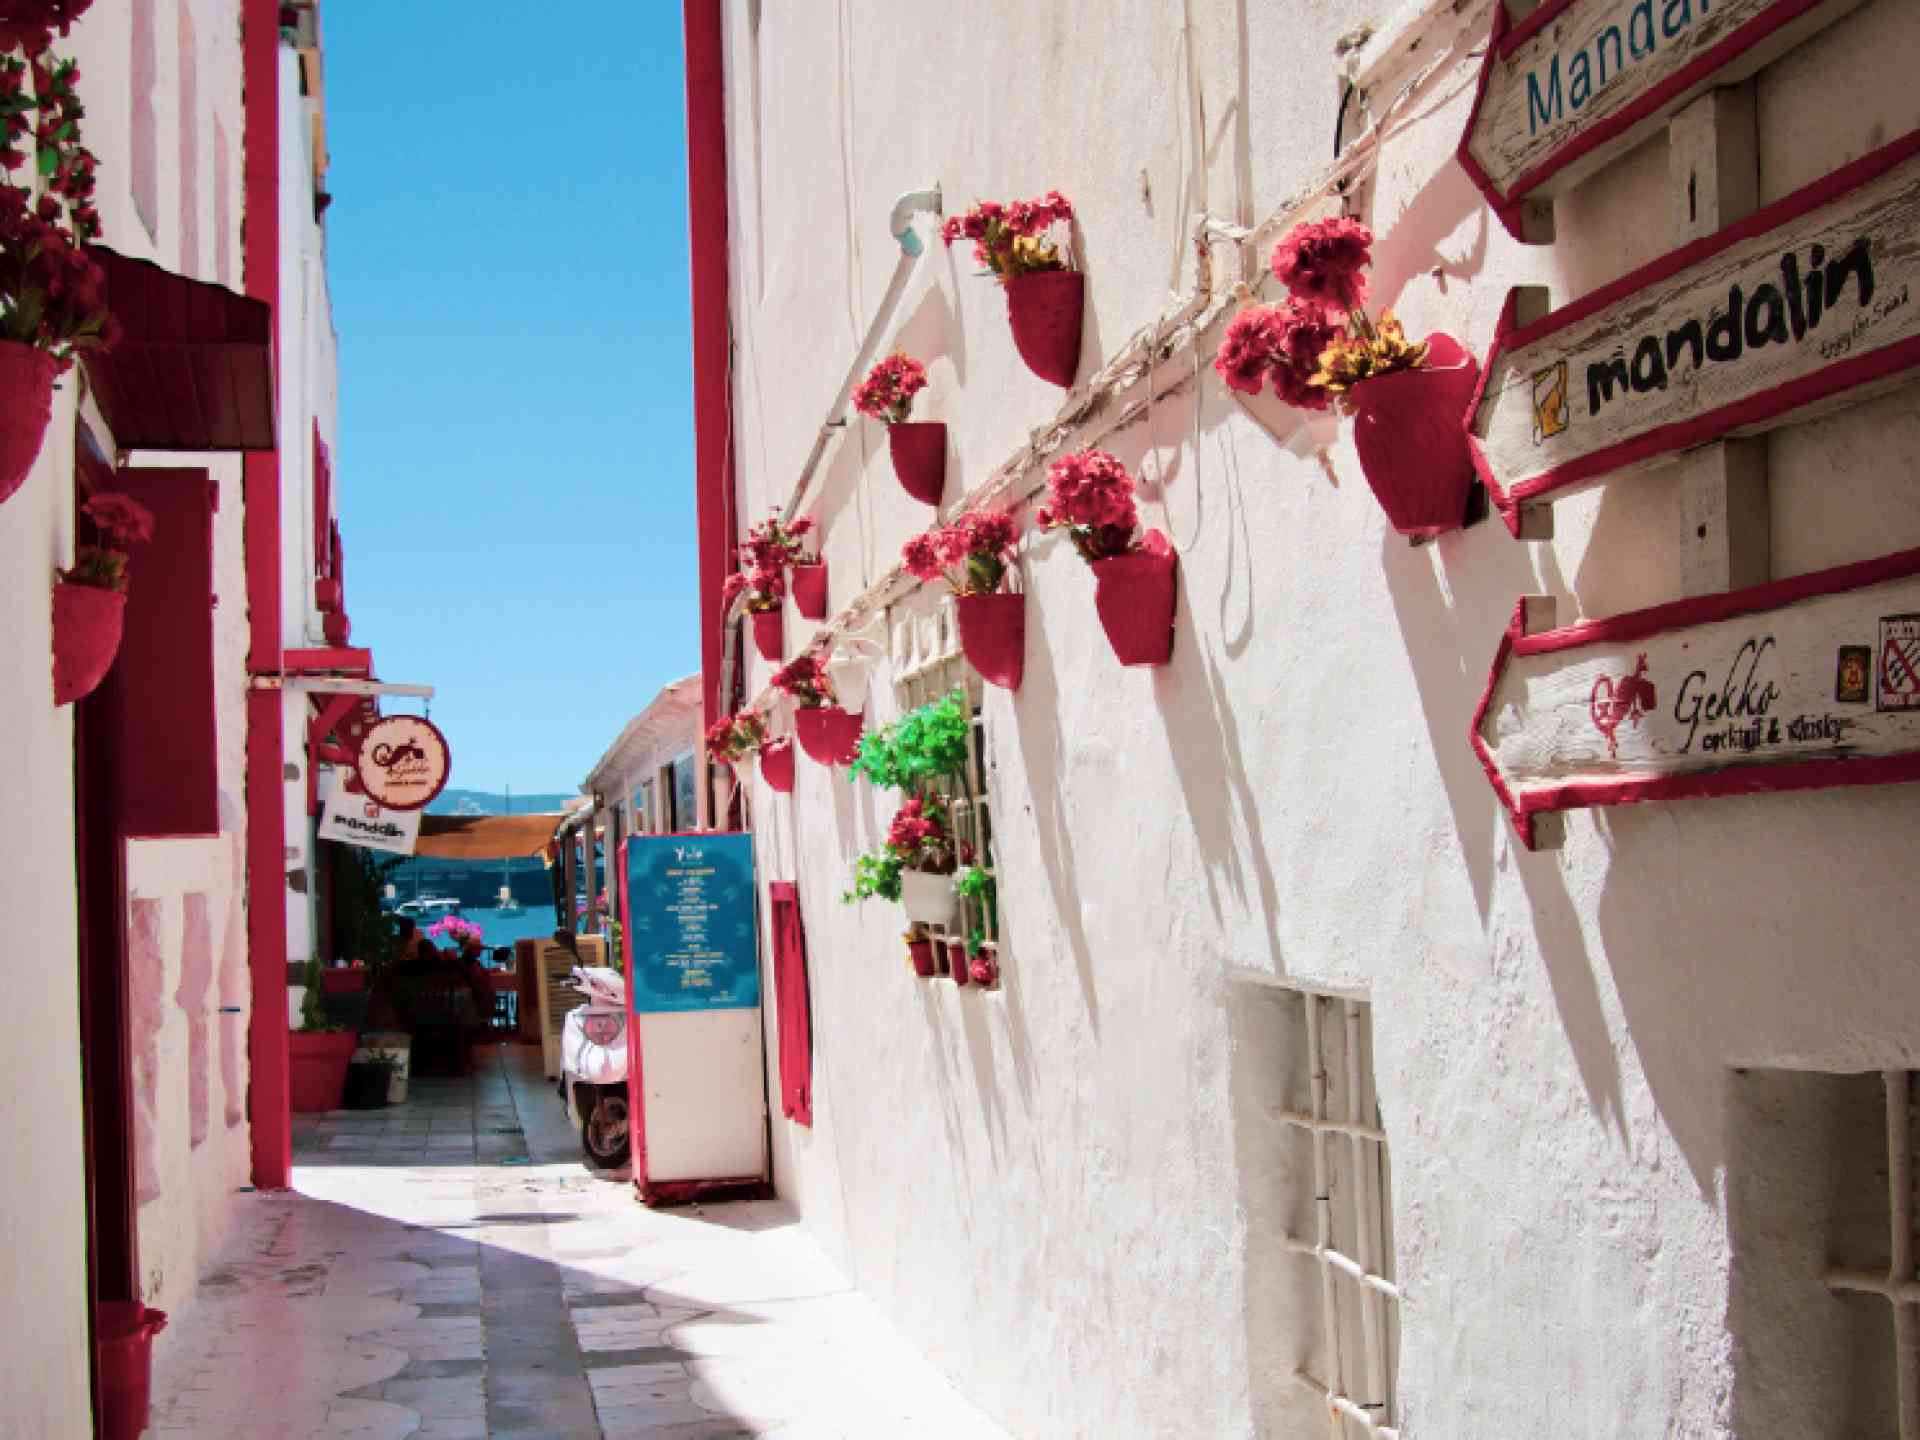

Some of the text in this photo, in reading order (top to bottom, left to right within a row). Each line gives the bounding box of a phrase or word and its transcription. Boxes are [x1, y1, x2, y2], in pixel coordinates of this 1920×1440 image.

[1527, 0, 1709, 136] Manda
[1587, 236, 1874, 415] mandalin
[1675, 636, 1780, 754] Gekko
